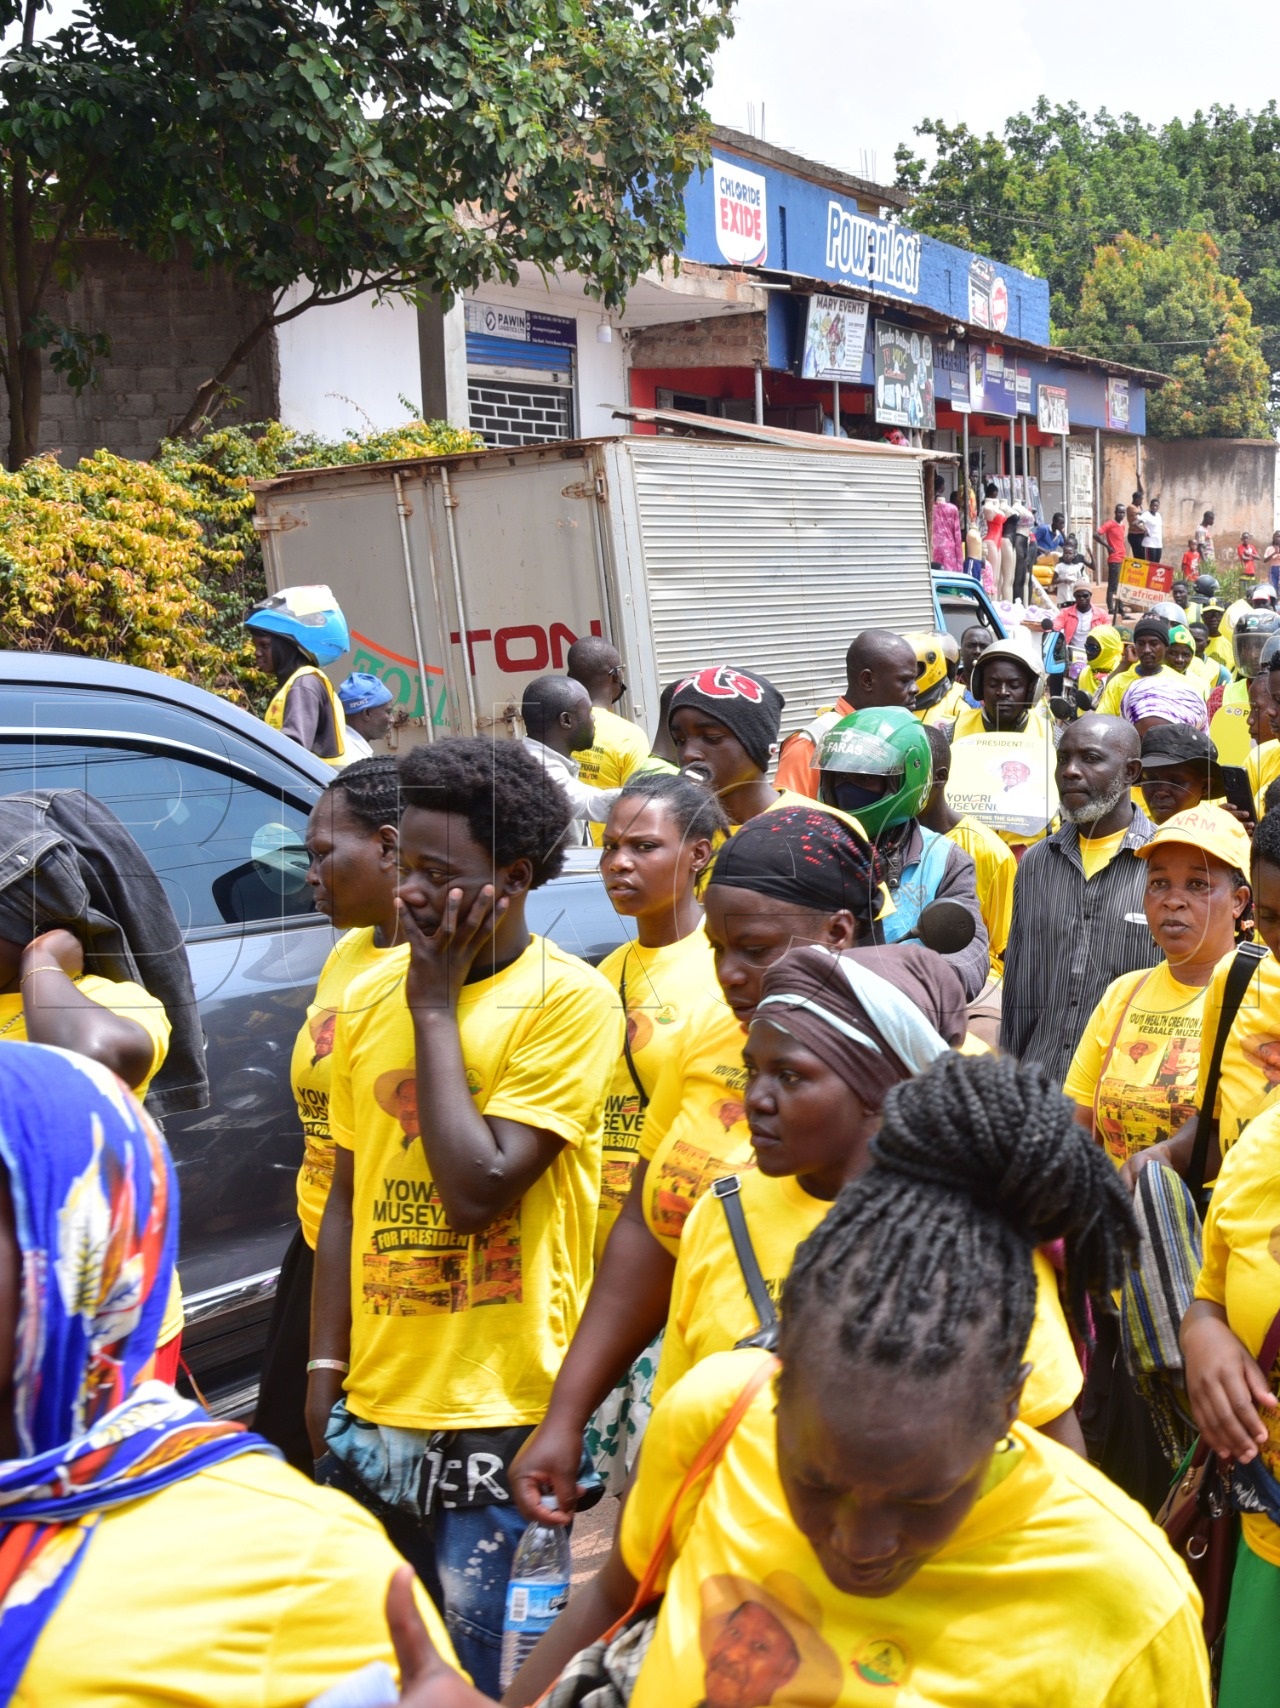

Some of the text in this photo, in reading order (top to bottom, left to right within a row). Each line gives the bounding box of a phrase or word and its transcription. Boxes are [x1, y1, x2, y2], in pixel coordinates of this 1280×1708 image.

[719, 176, 761, 207] CHLORIDE
[720, 197, 762, 241] EXIDE
[816, 296, 865, 315] MARY EVENTS
[498, 313, 525, 329] PAWIN
[498, 325, 517, 333] LOGISTICS
[1132, 589, 1164, 602] africell
[450, 619, 602, 676] TON
[349, 697, 369, 709] SPORT
[826, 742, 864, 756] FARAS
[976, 739, 1024, 748] PRESIDENT
[1171, 813, 1216, 832] NRM
[1145, 1013, 1169, 1027] WEALTH
[1168, 1015, 1201, 1029] CREATION
[297, 1086, 330, 1106] YOW
[384, 1178, 437, 1203] YOW
[373, 1199, 449, 1226] MUSEV
[377, 1229, 469, 1250] FOR PRESIDEN
